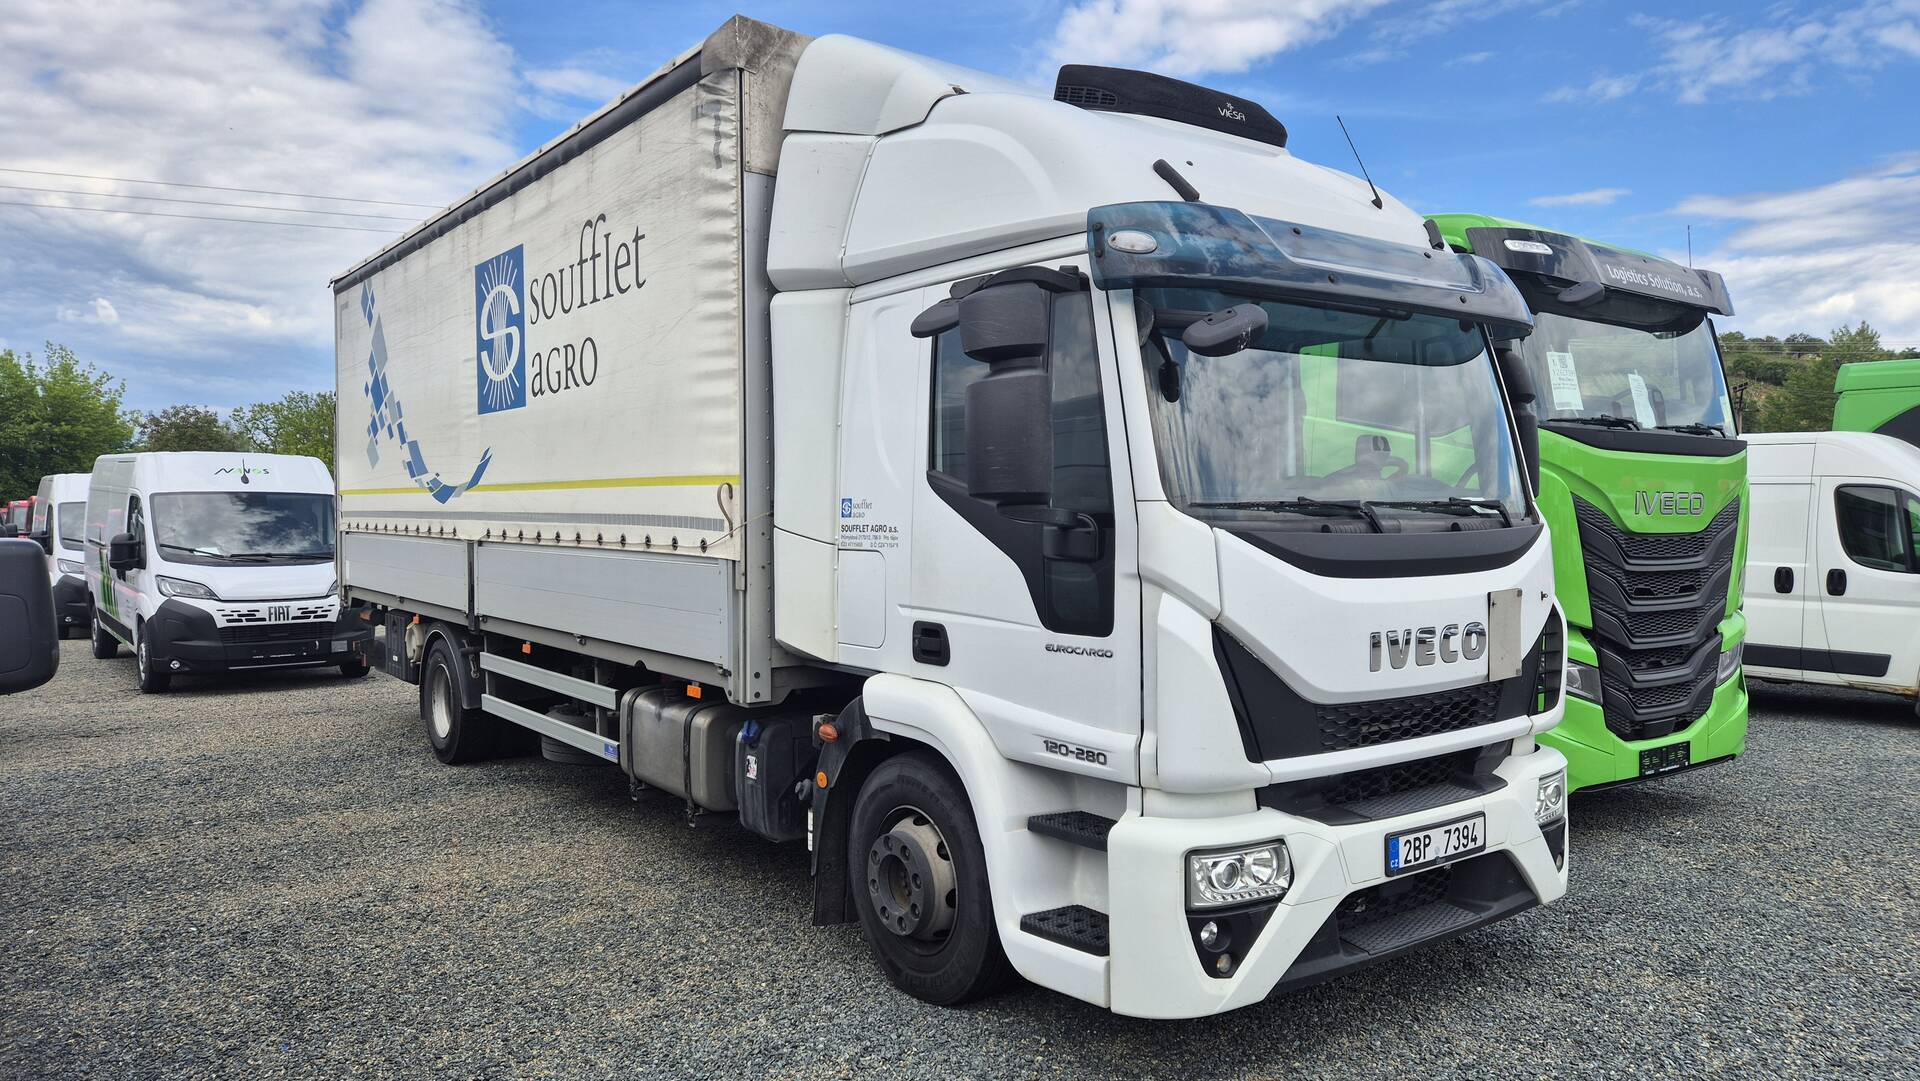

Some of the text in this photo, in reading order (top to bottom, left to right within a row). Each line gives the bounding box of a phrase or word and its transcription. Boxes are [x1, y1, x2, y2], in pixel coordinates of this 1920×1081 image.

[1218, 106, 1245, 122] VIESA
[529, 213, 647, 325] soufflet
[1606, 264, 1703, 299] Logistics Solution, a.s.
[1635, 491, 1704, 515] IVECO
[841, 525, 869, 533] SOUFFLET
[870, 525, 888, 533] AGRO
[268, 605, 291, 622] FIAT
[1045, 643, 1114, 658] EUROCARGO
[1369, 621, 1487, 672] IVECO
[1043, 740, 1107, 765] 120-280
[1403, 822, 1478, 865] 2BP 7394
[1390, 859, 1399, 868] CZ
